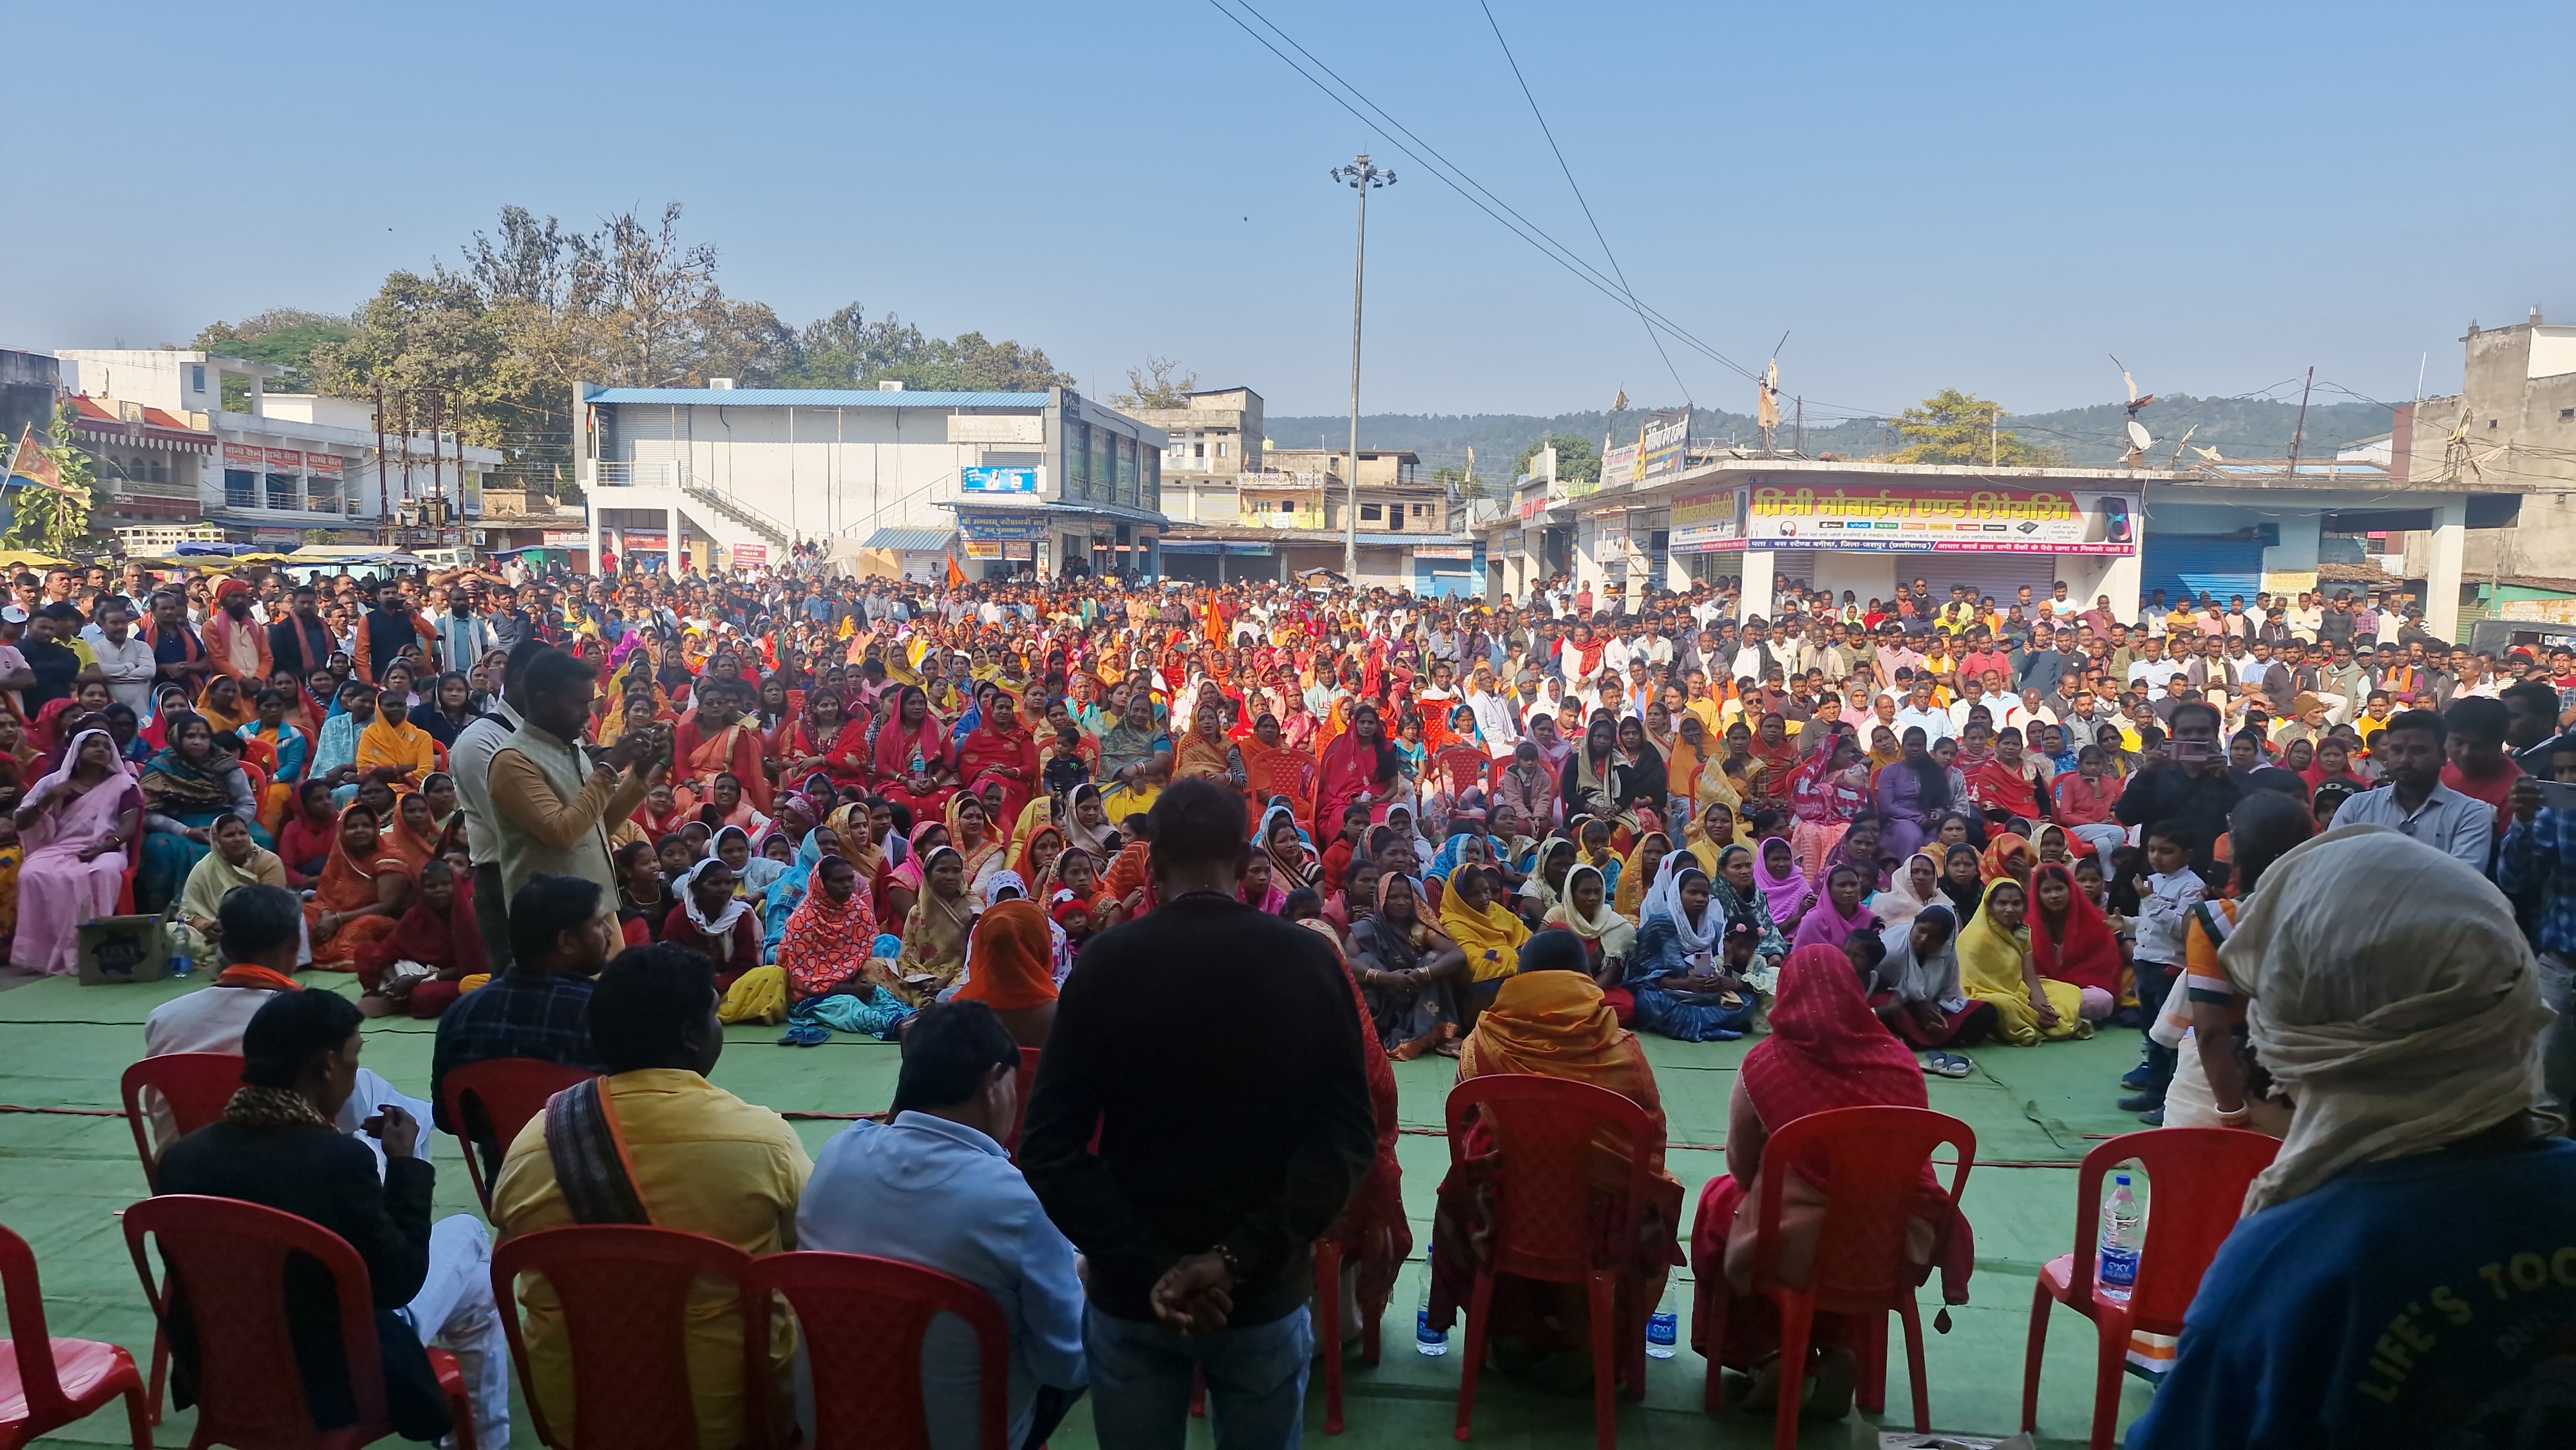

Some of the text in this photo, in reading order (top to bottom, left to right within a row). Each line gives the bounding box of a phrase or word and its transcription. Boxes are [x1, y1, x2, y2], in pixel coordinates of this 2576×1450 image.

[1817, 488, 1913, 519] मोबाईल
[1915, 499, 1967, 518] एण्ड
[1970, 491, 2072, 520] रिपेयरिंग
[2108, 1261, 2130, 1272] OXY
[1653, 1324, 1671, 1333] OXY
